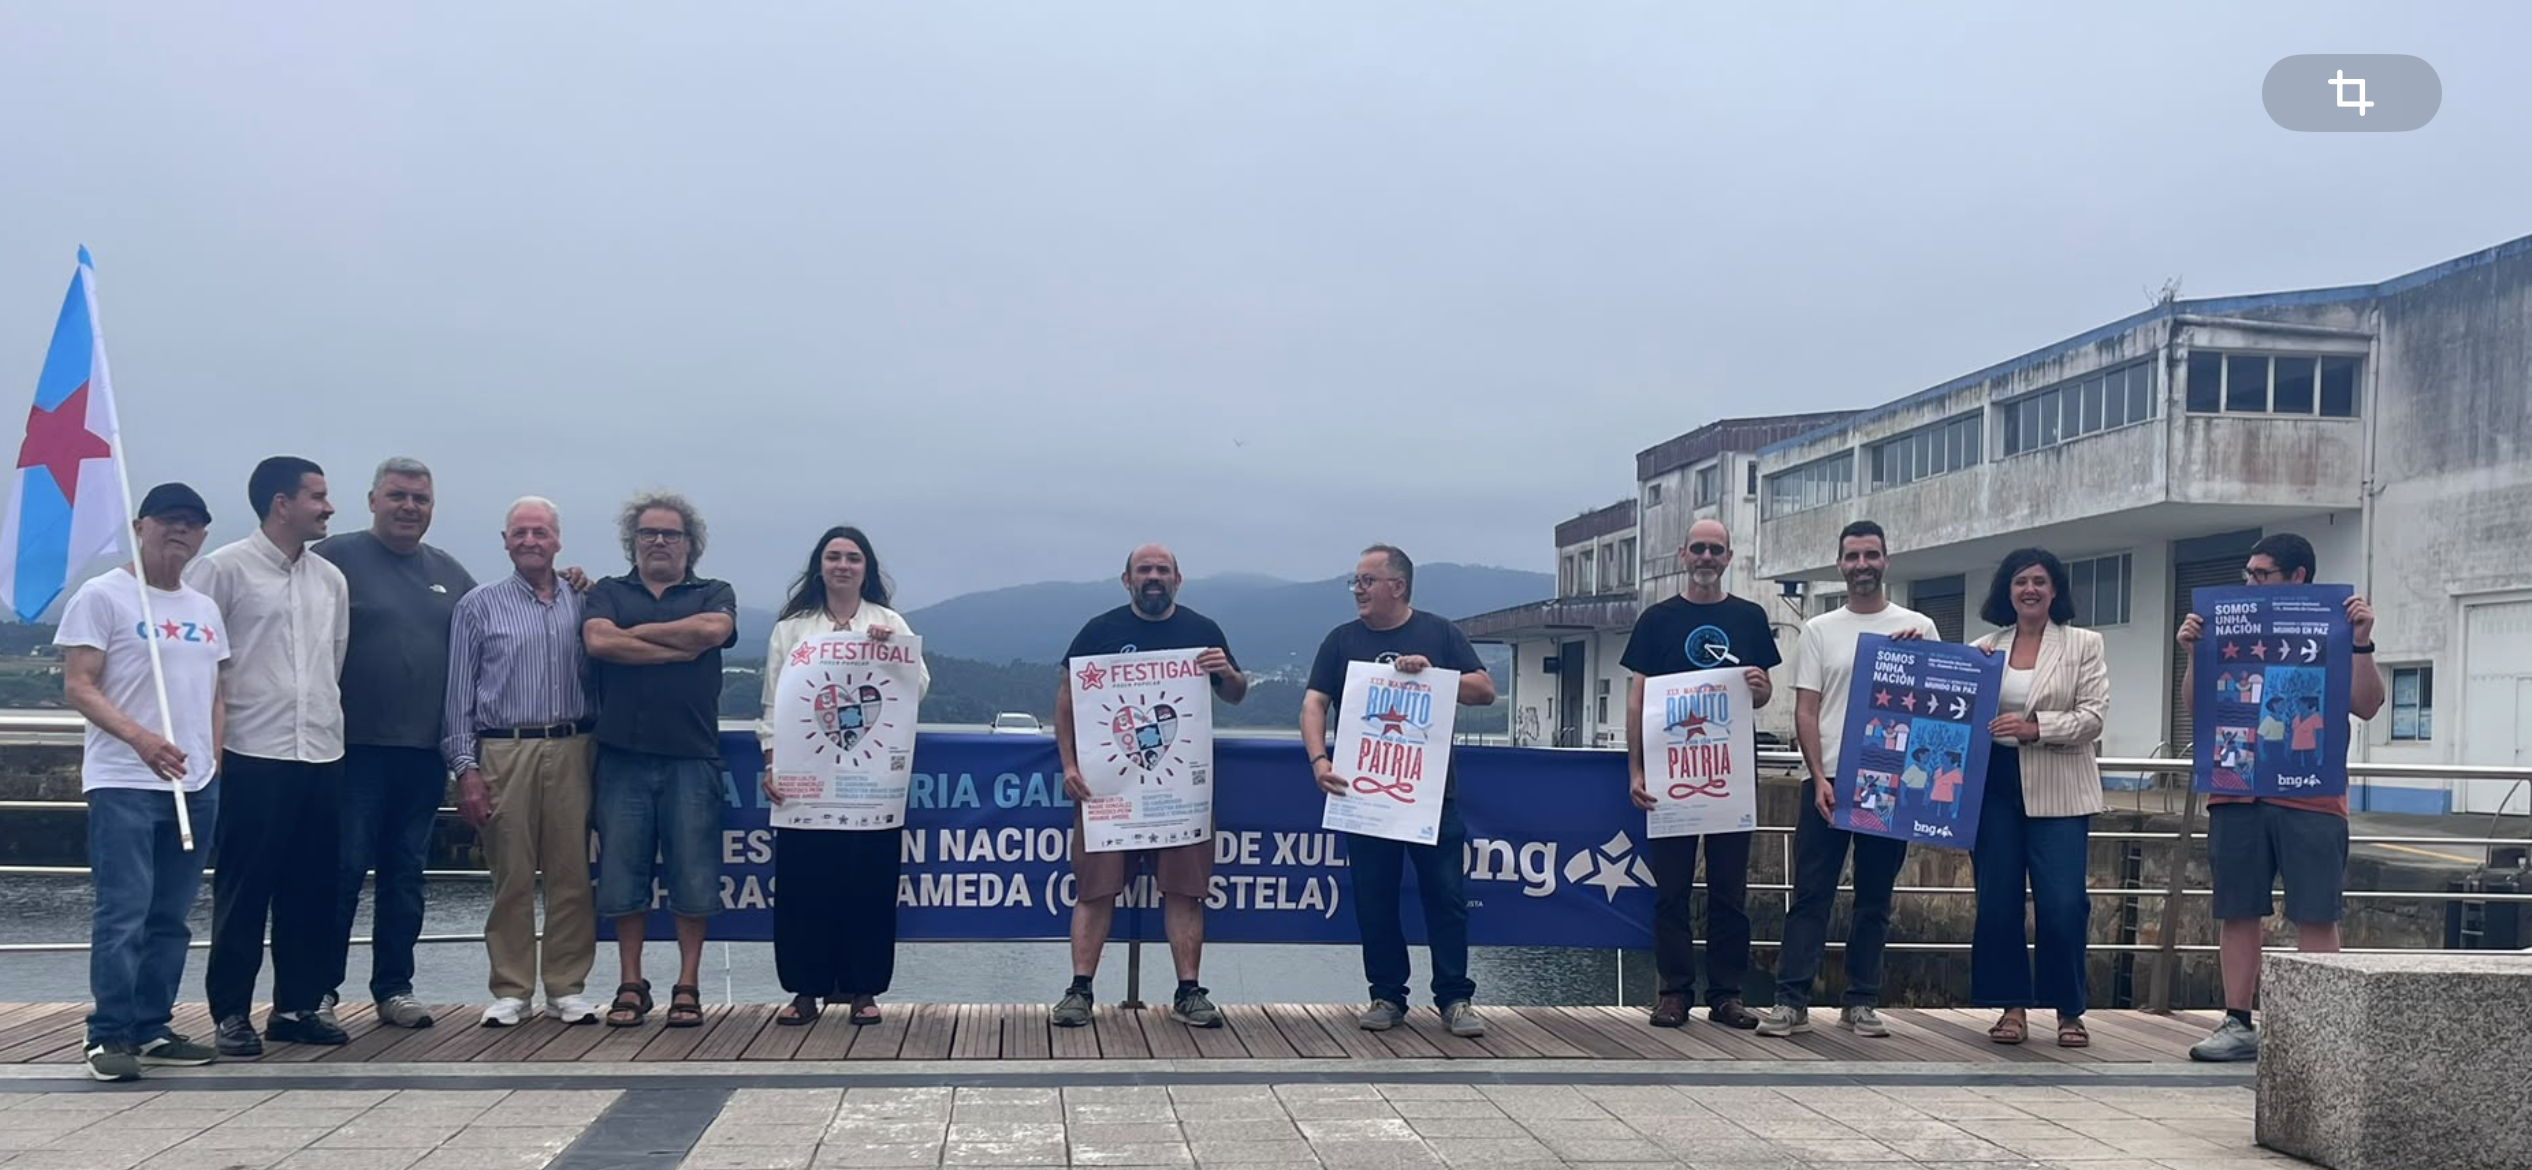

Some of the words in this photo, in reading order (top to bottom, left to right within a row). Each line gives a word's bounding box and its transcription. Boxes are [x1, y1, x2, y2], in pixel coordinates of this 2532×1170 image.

[2215, 603, 2257, 615] SOMOS
[2216, 615, 2248, 625] UNHA
[2216, 622, 2261, 636] NACIÓN
[2313, 627, 2329, 635] PAZ
[820, 642, 916, 664] FESTIGAL
[1877, 650, 1915, 665] SOMOS
[1112, 660, 1204, 682] FESTIGAL
[1875, 662, 1904, 673] UNHA
[1873, 671, 1915, 686] NACIÓN
[1925, 682, 1950, 691] MUNDO
[1963, 686, 1977, 694] PAZ
[1366, 686, 1431, 724] BONITO
[1666, 693, 1728, 726] BONITO
[1357, 738, 1423, 781] PATRIA
[1668, 743, 1731, 779] PATRIA
[994, 772, 1074, 808] GAL
[2277, 774, 2302, 788] bng
[1914, 820, 1936, 836] bng
[939, 828, 1073, 862] NACIO
[1214, 831, 1261, 865] DE
[1271, 832, 1350, 866] XUL
[1463, 838, 1557, 897] ng
[896, 873, 1033, 907] AMEDA
